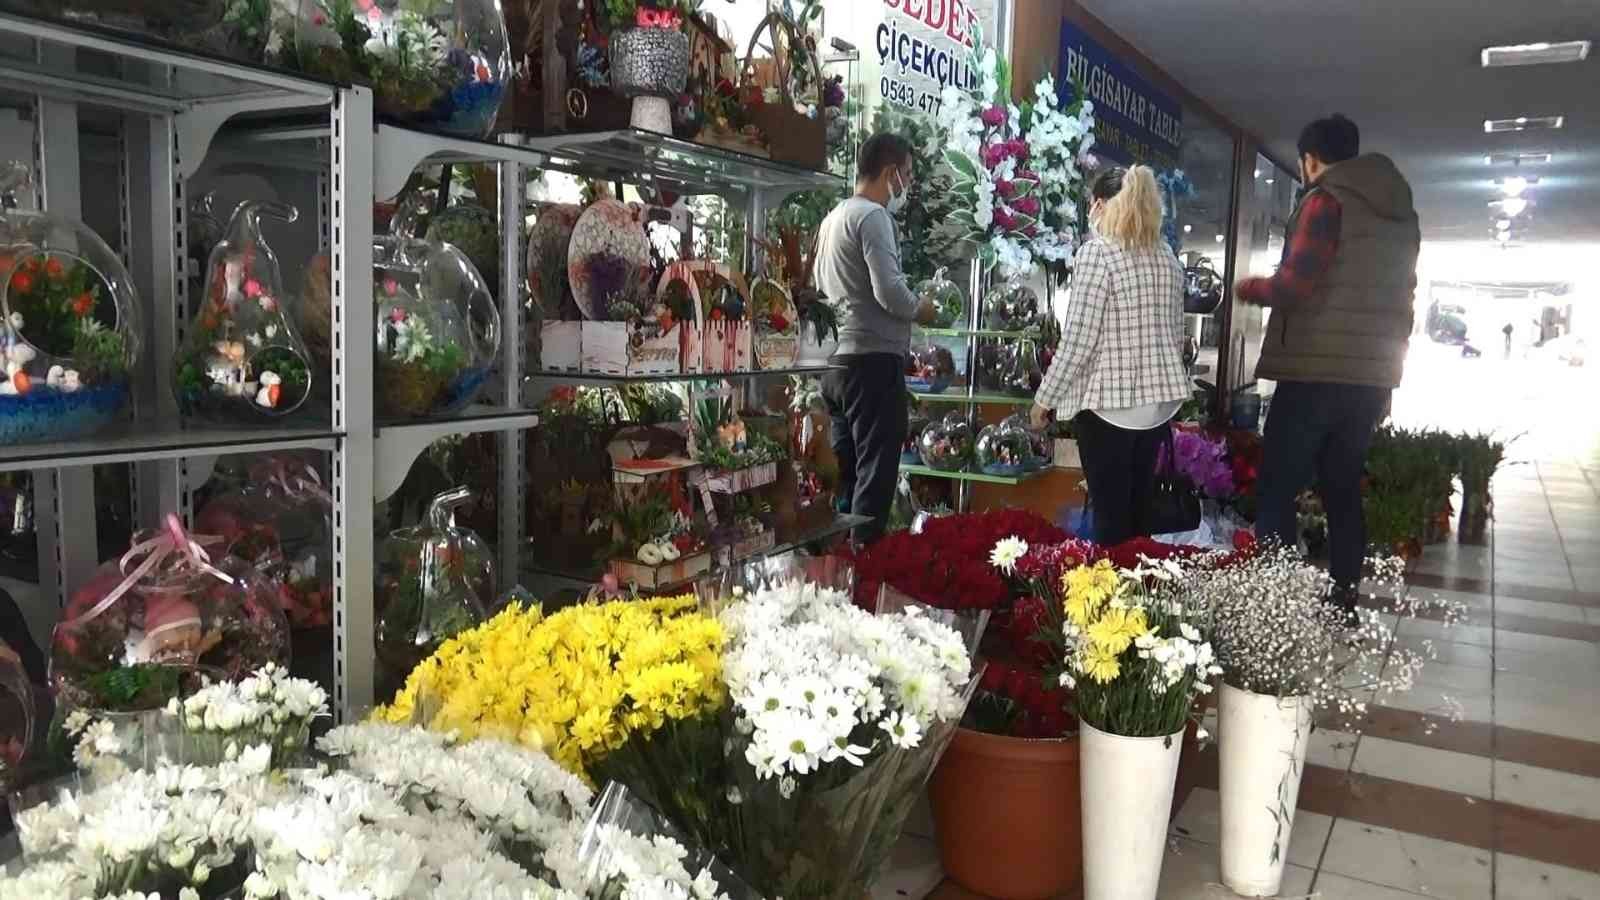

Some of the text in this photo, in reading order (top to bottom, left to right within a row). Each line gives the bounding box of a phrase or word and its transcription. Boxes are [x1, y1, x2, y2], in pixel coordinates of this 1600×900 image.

[880, 76, 942, 117] 0543 477
[1065, 45, 1146, 128] BİLGİSAYAR
